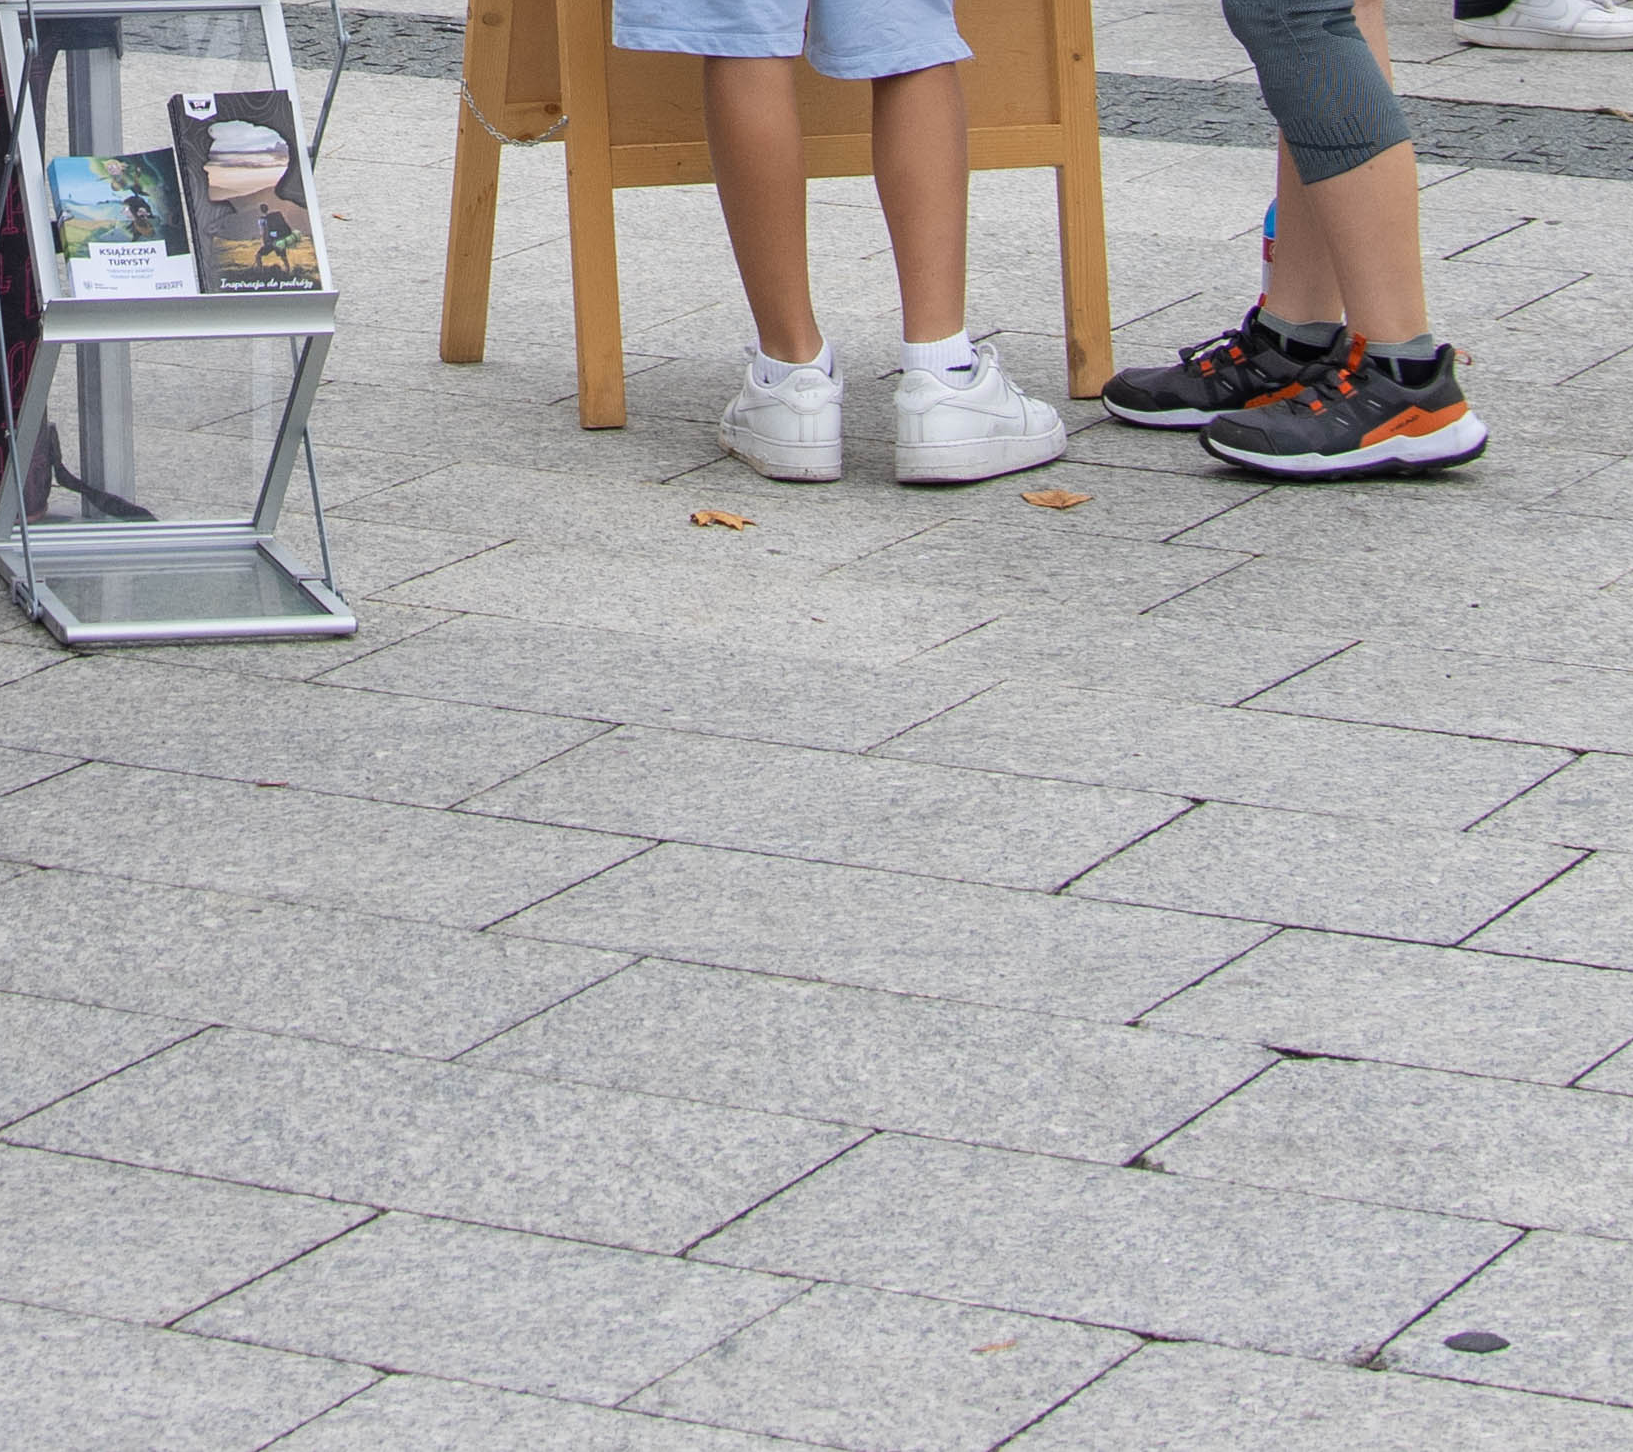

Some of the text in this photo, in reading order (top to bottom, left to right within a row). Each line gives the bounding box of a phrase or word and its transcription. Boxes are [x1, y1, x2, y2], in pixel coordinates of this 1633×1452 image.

[99, 246, 157, 257] KSIĄŻECZKA
[108, 258, 150, 266] TURYSTY
[220, 276, 314, 290] Inspiracja do podróży
